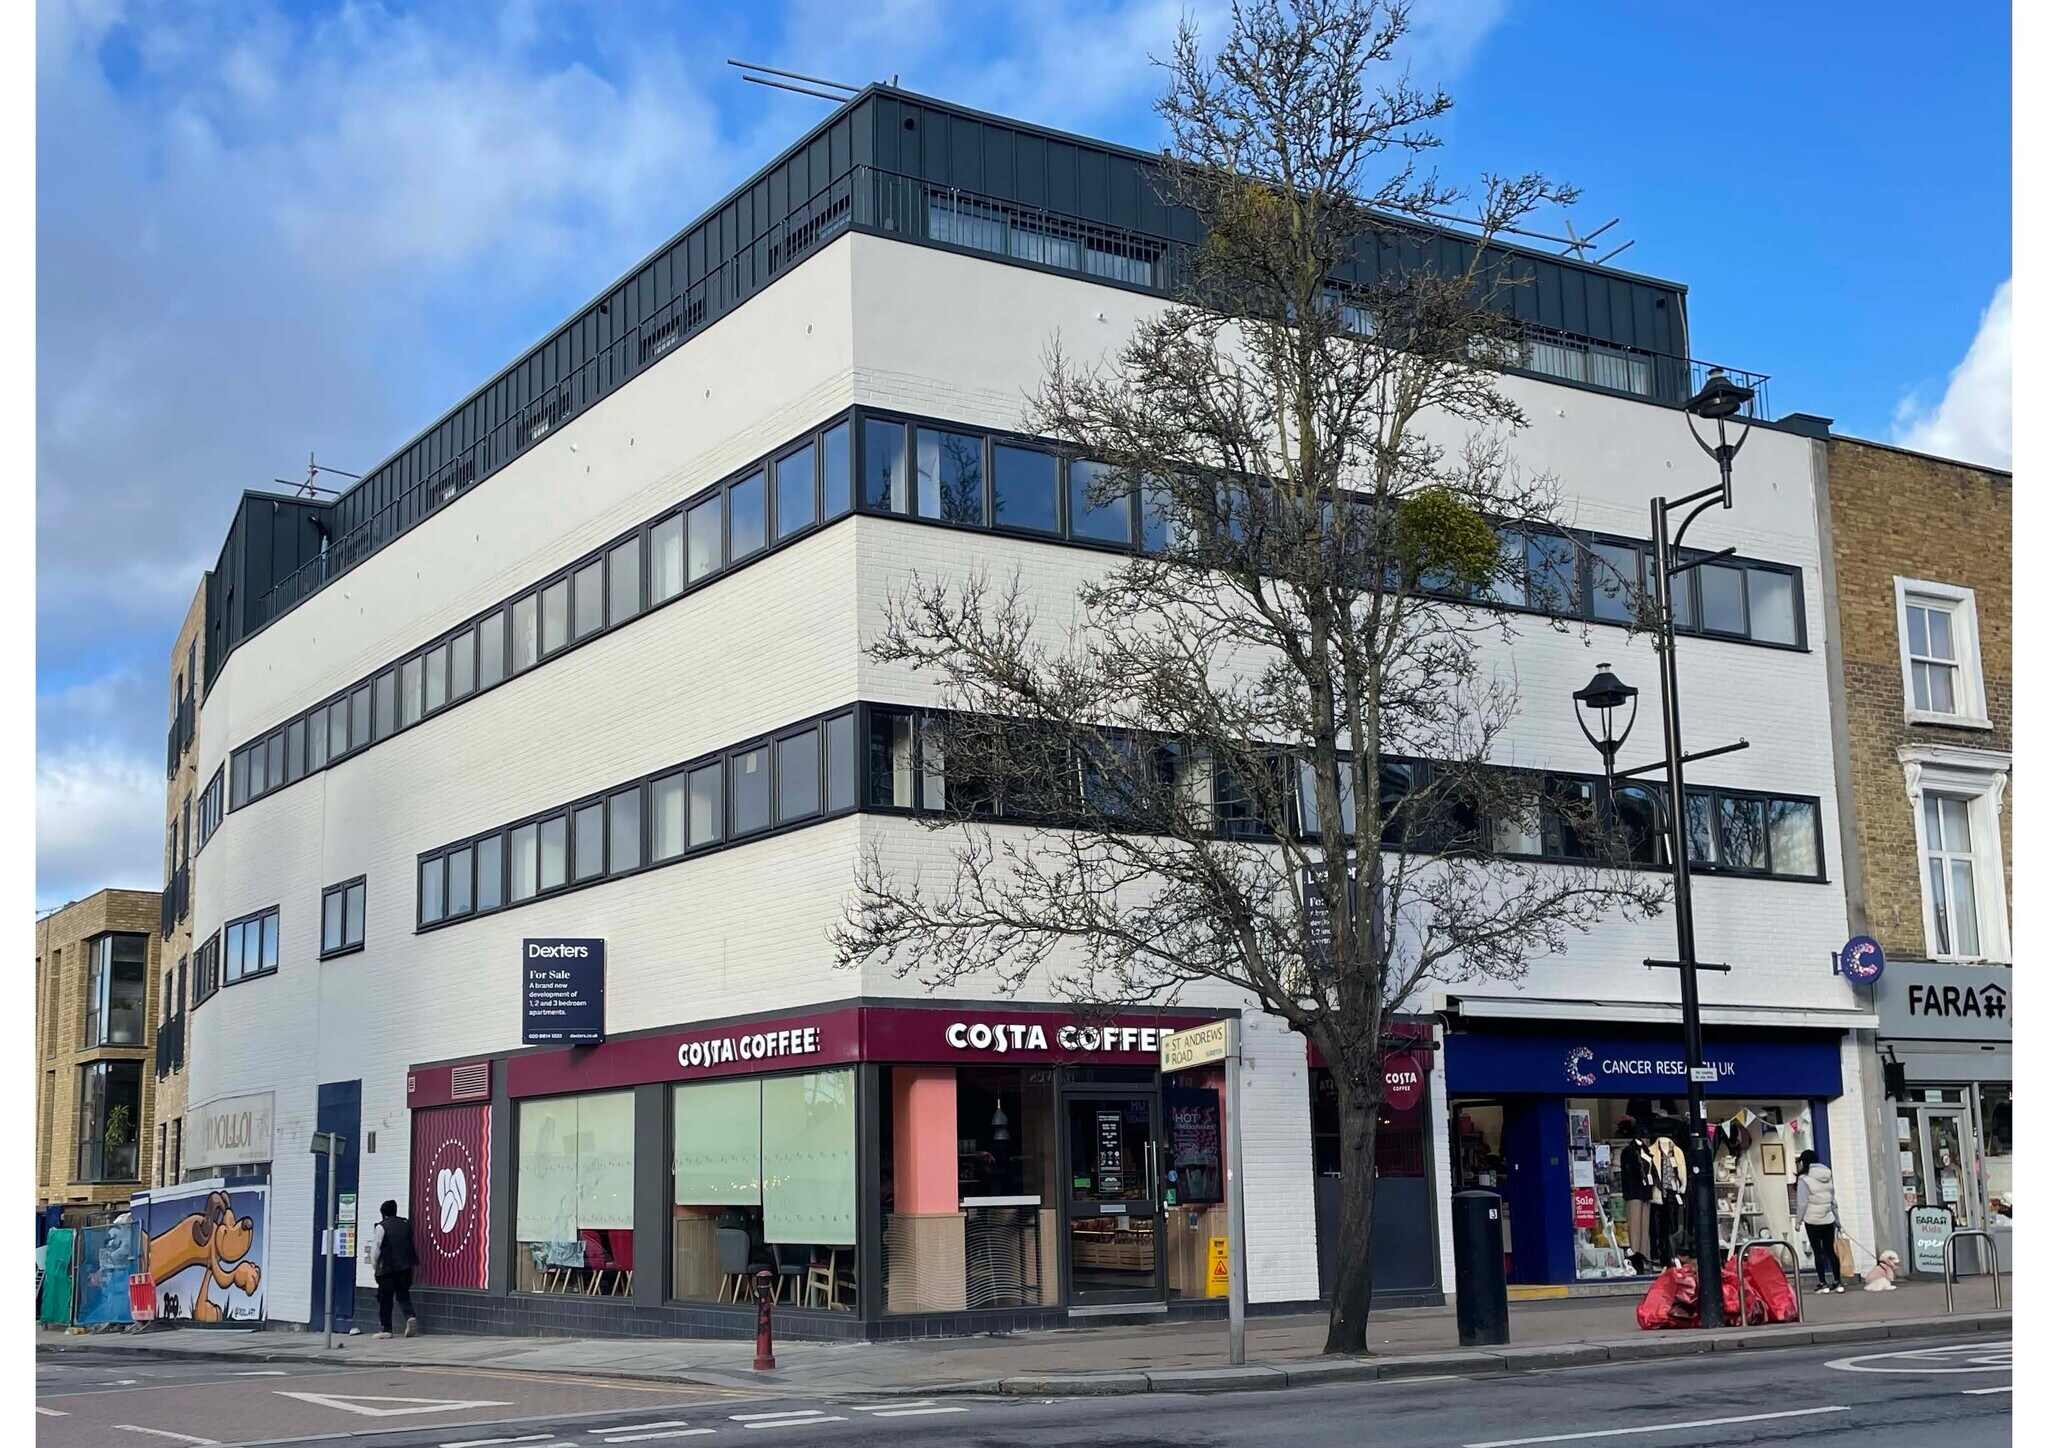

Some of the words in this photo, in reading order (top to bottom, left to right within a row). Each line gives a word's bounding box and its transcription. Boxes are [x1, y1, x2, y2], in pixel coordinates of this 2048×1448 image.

[529, 943, 588, 958] Dexters
[529, 970, 547, 979] For
[549, 970, 570, 979] Sale
[1908, 985, 1981, 1018] FARA
[945, 1023, 1048, 1053] COSTA
[1171, 1037, 1181, 1051] ST
[1184, 1027, 1223, 1047] ANDREWS
[678, 1038, 738, 1067] COSTA
[740, 1027, 820, 1060] COFFEE
[1171, 1049, 1193, 1065] ROAD
[1602, 1060, 1652, 1074] CANCER
[1719, 1062, 1735, 1075] UK
[1385, 1072, 1417, 1085] COSTA
[1175, 1113, 1199, 1123] HOT
[1575, 1196, 1593, 1205] Sale
[1915, 1216, 1940, 1224] FARA
